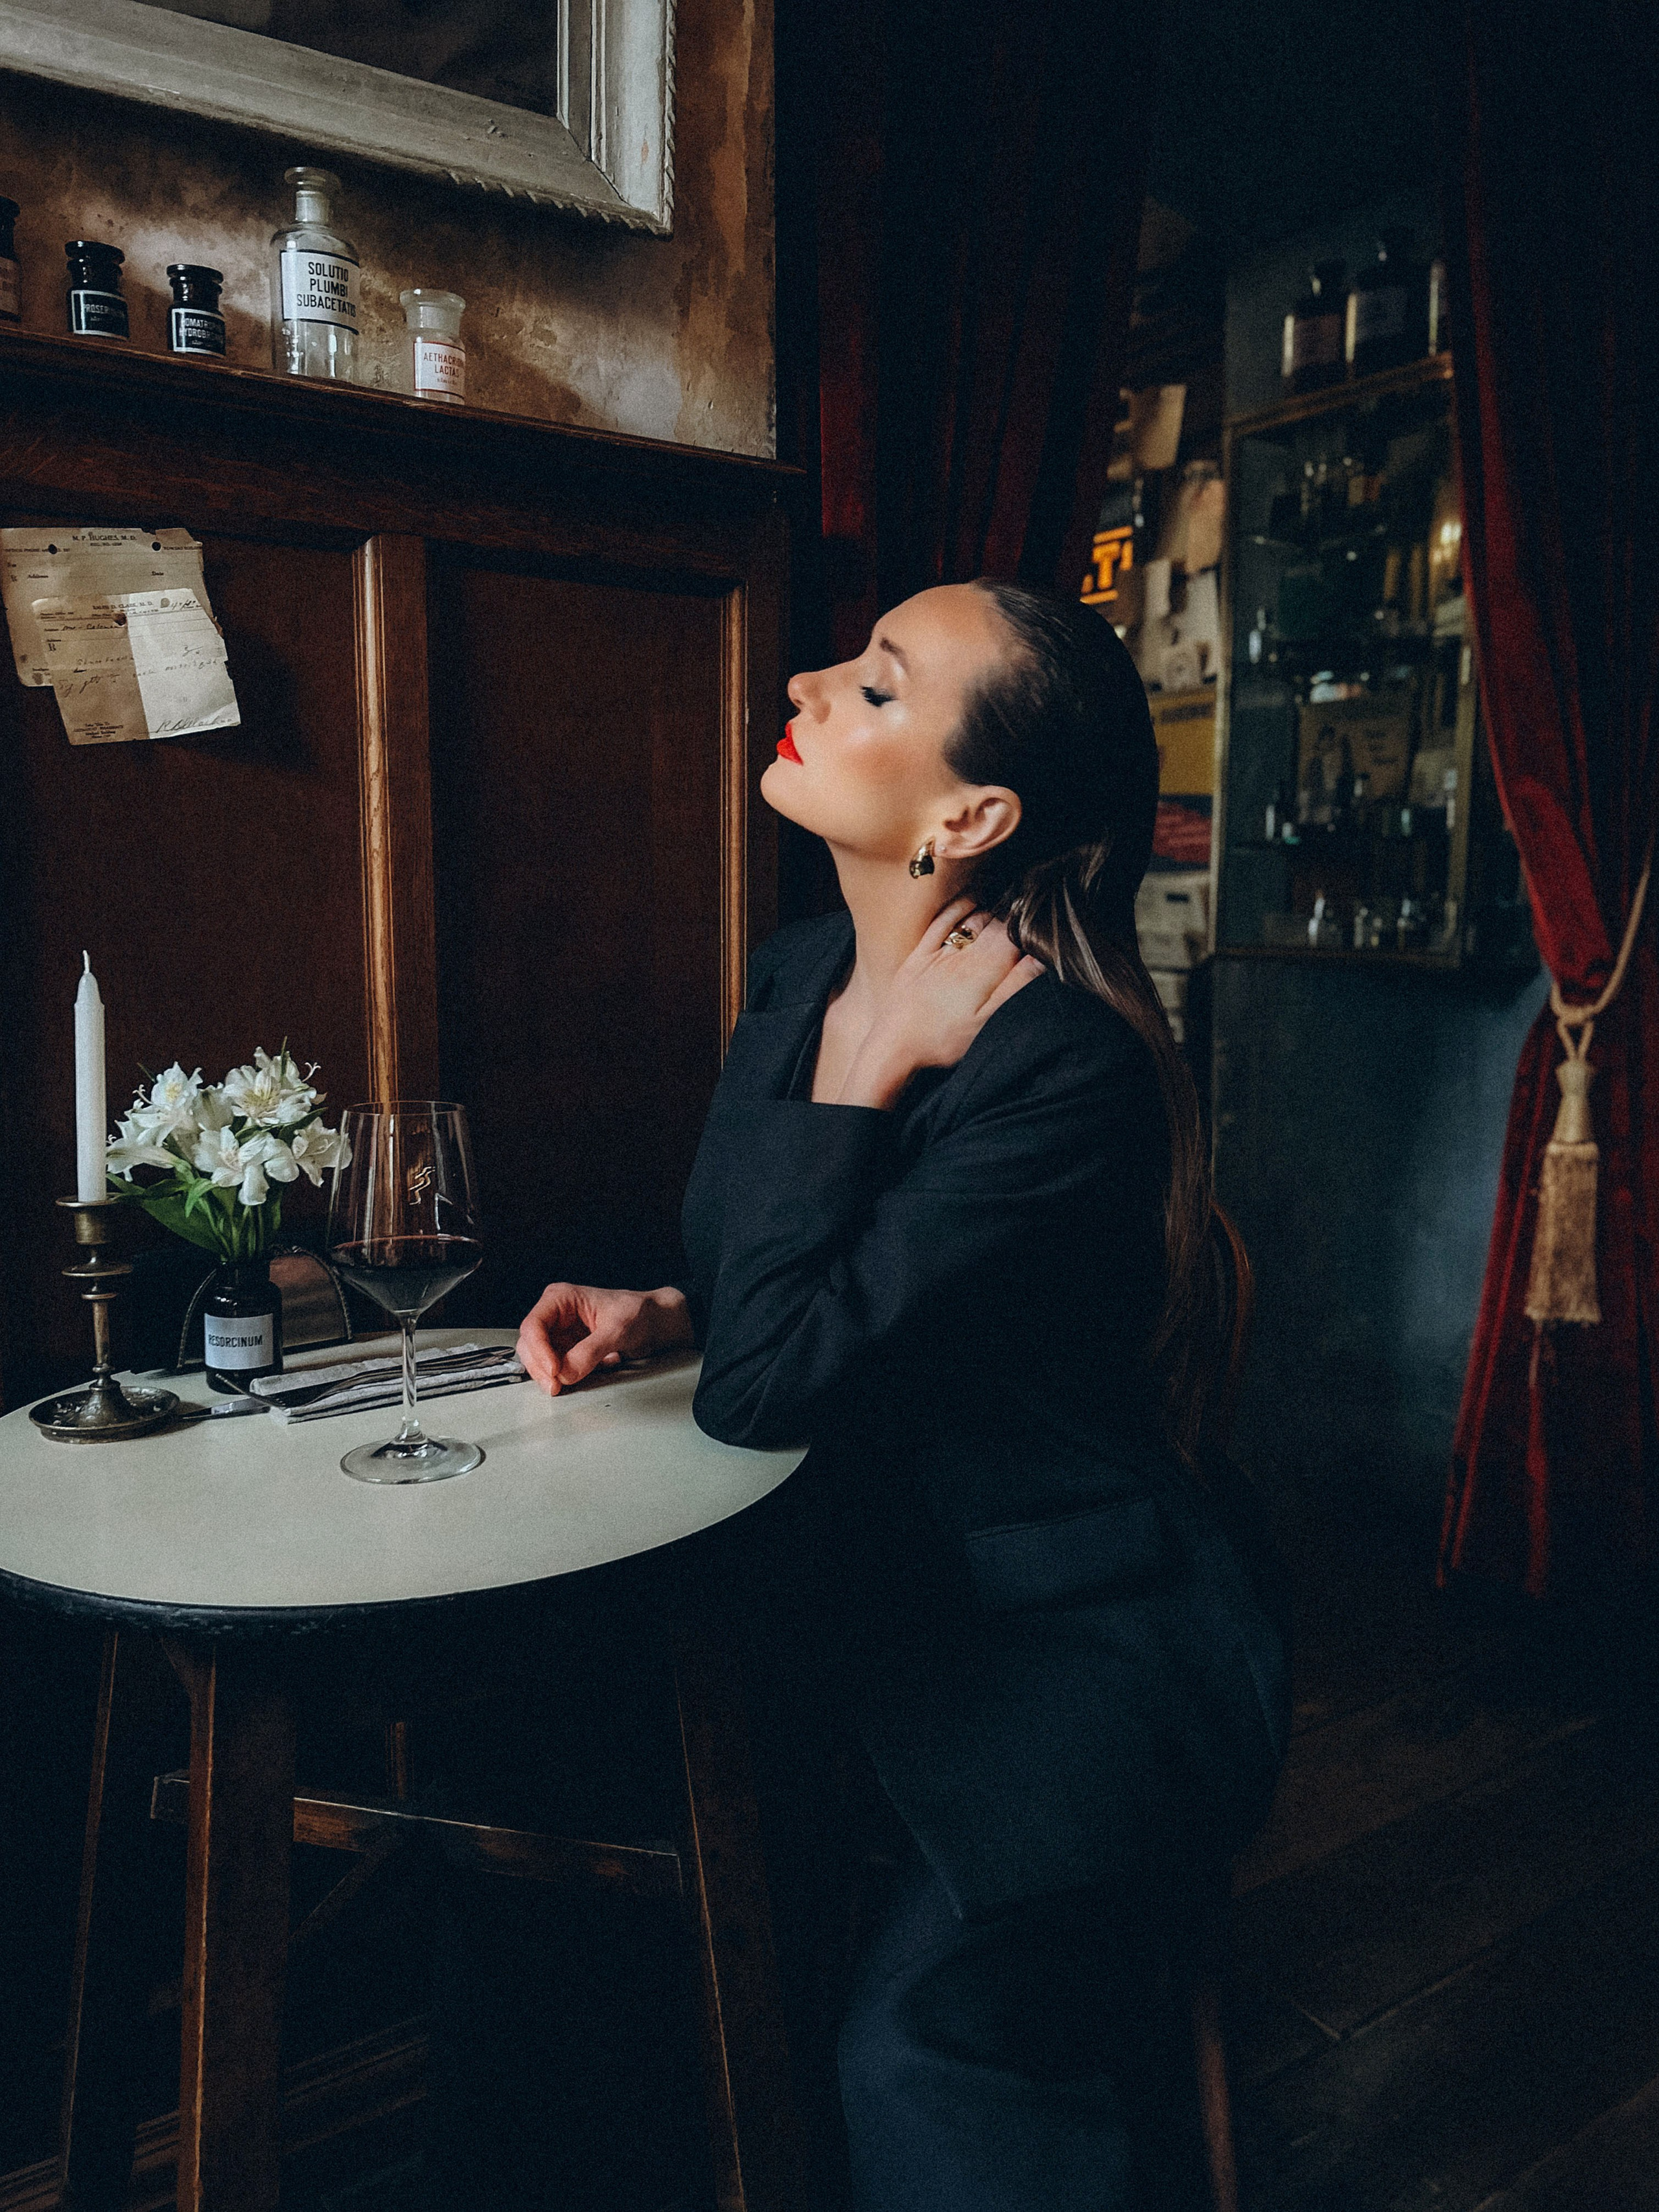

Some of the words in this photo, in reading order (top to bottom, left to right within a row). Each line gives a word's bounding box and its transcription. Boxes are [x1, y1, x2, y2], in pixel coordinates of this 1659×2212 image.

[308, 261, 349, 282] SOLUTIO
[310, 278, 349, 297] PLUMBI
[208, 1334, 263, 1348] RESORCINUM
